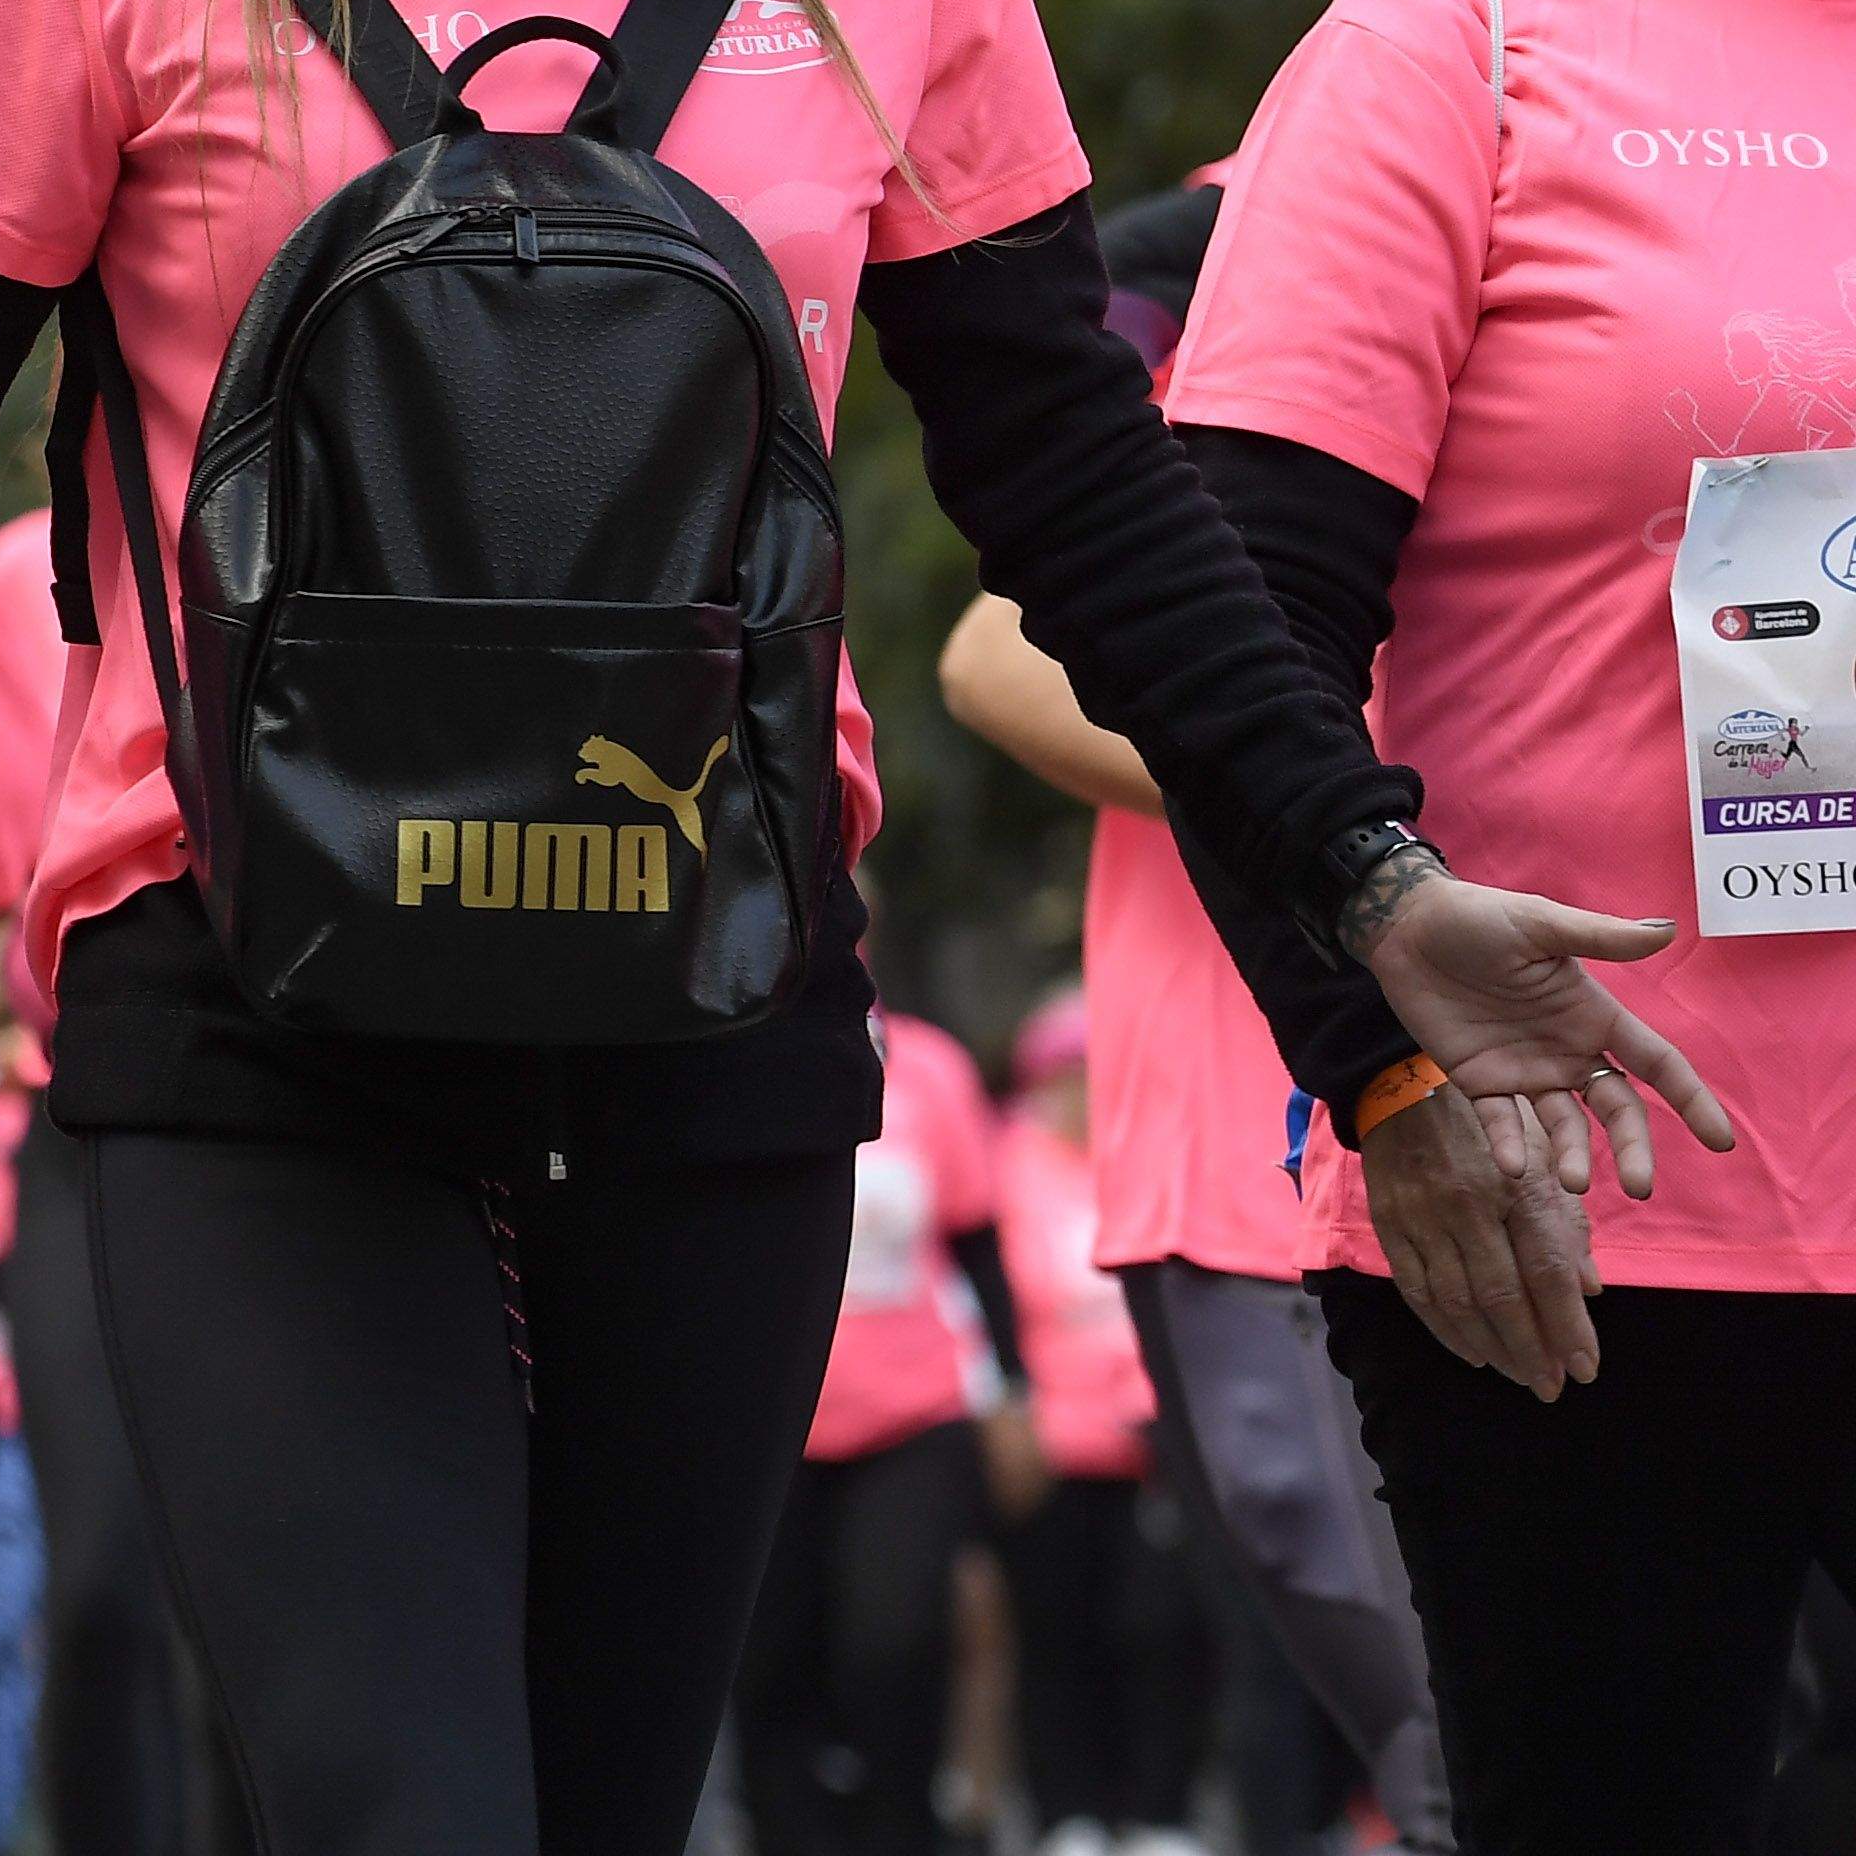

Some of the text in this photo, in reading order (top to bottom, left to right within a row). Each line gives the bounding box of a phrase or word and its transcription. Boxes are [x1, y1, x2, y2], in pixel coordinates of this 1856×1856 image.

[704, 27, 822, 58] STURIAN
[1611, 127, 1830, 170] OYSHO
[1755, 617, 1810, 631] Barcelona
[1713, 740, 1770, 758] Carrera
[1719, 795, 1854, 827] CURSA DE
[395, 819, 670, 913] PUMA
